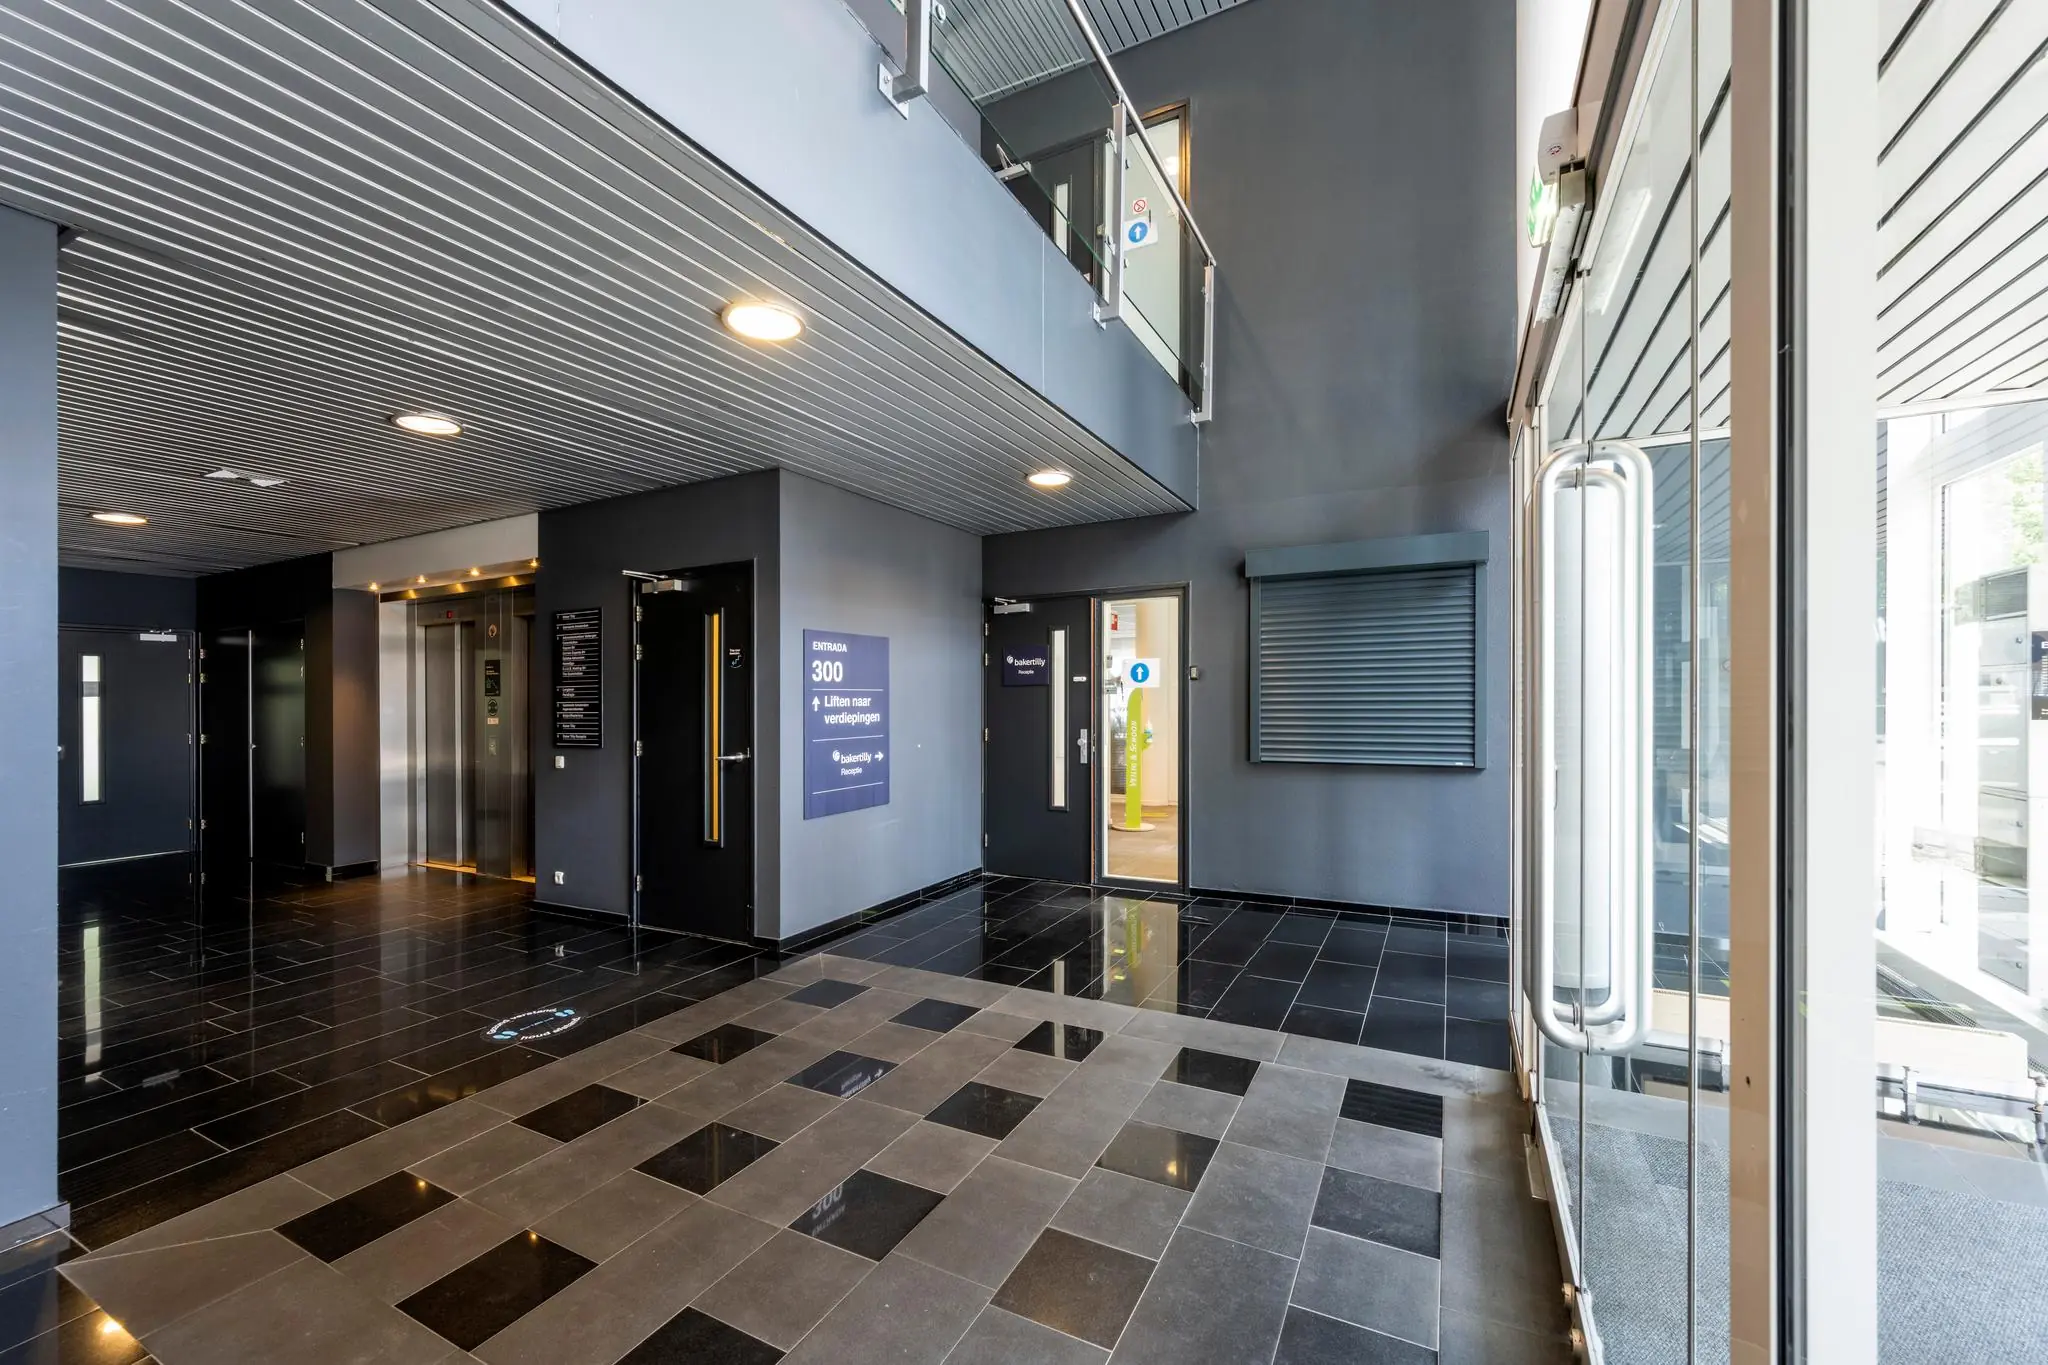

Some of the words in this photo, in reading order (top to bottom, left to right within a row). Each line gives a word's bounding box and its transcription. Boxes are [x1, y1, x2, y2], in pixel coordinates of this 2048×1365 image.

[812, 641, 847, 652] ENTRADA
[1014, 657, 1045, 667] bakertilly
[811, 660, 843, 682] 300
[824, 695, 850, 707] Liften
[852, 697, 871, 707] naar
[824, 711, 880, 726] verdiepingen
[840, 752, 872, 764] bakertilly
[840, 766, 862, 776] Receptie
[520, 1031, 551, 1041] houd
